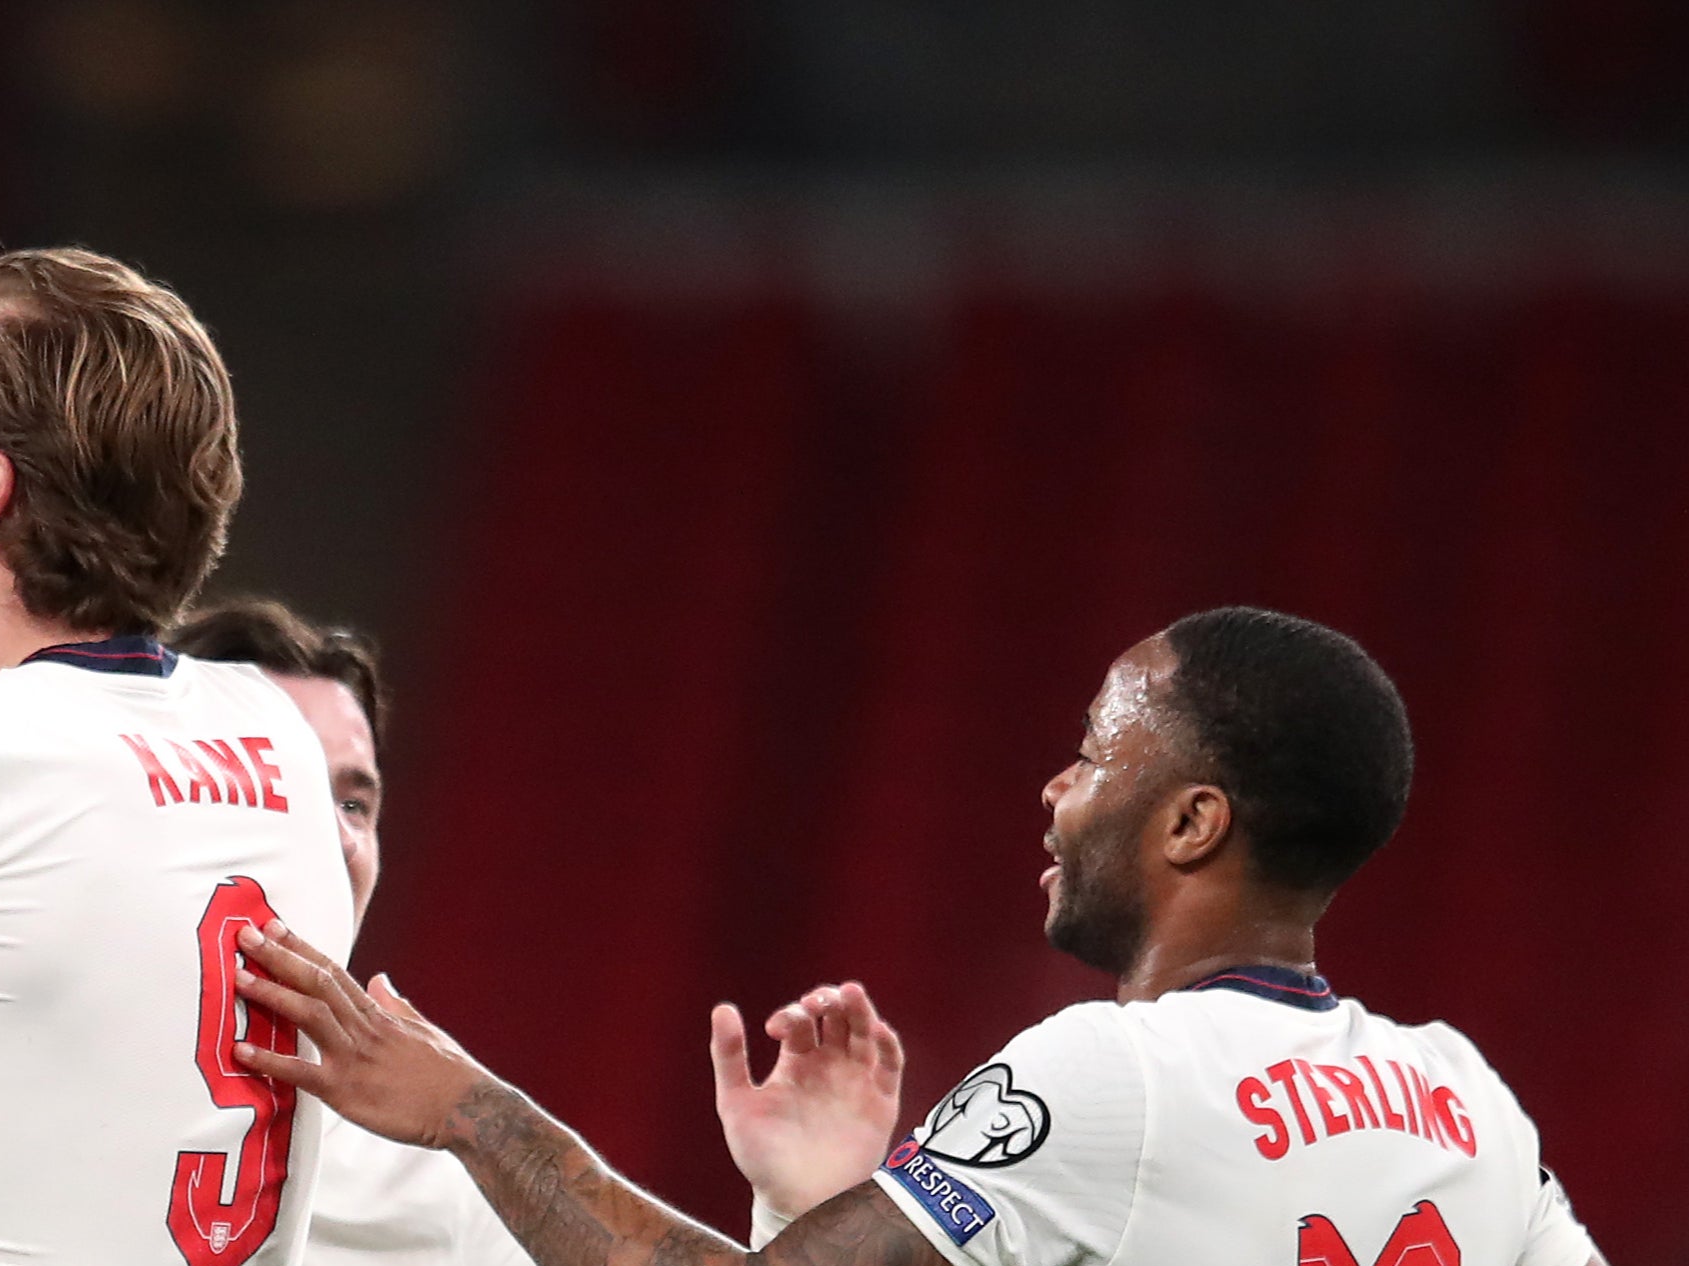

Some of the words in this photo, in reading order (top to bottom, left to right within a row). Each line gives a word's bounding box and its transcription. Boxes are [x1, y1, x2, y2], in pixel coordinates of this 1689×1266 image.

[118, 733, 289, 814] KANE
[1235, 1055, 1477, 1161] STERLING
[903, 1155, 985, 1233] RESPECT
